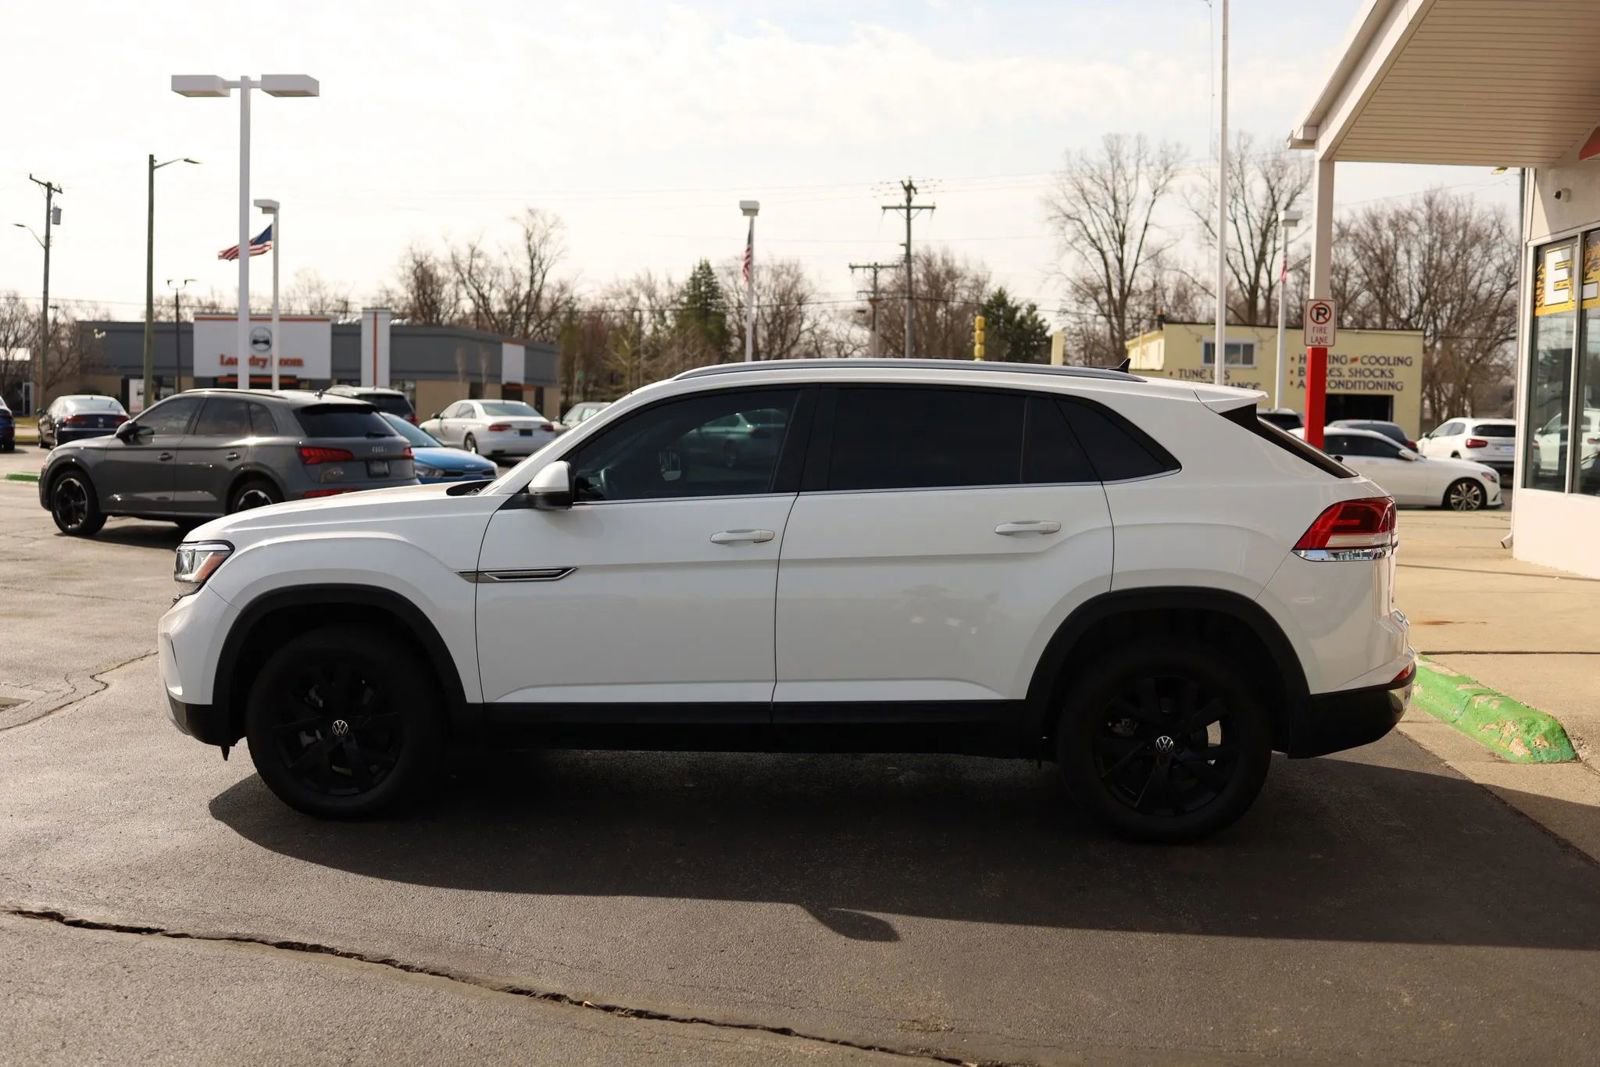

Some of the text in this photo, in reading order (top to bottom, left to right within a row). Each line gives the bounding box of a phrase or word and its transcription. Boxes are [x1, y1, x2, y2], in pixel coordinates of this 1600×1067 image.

[1312, 326, 1328, 334] FIRE
[220, 354, 304, 369] Ladry oom
[1298, 354, 1413, 367] HING COOLING
[1178, 368, 1207, 379] TUNE
[1348, 368, 1395, 379] SHOCKS
[1322, 380, 1404, 391] ONDITIONING
